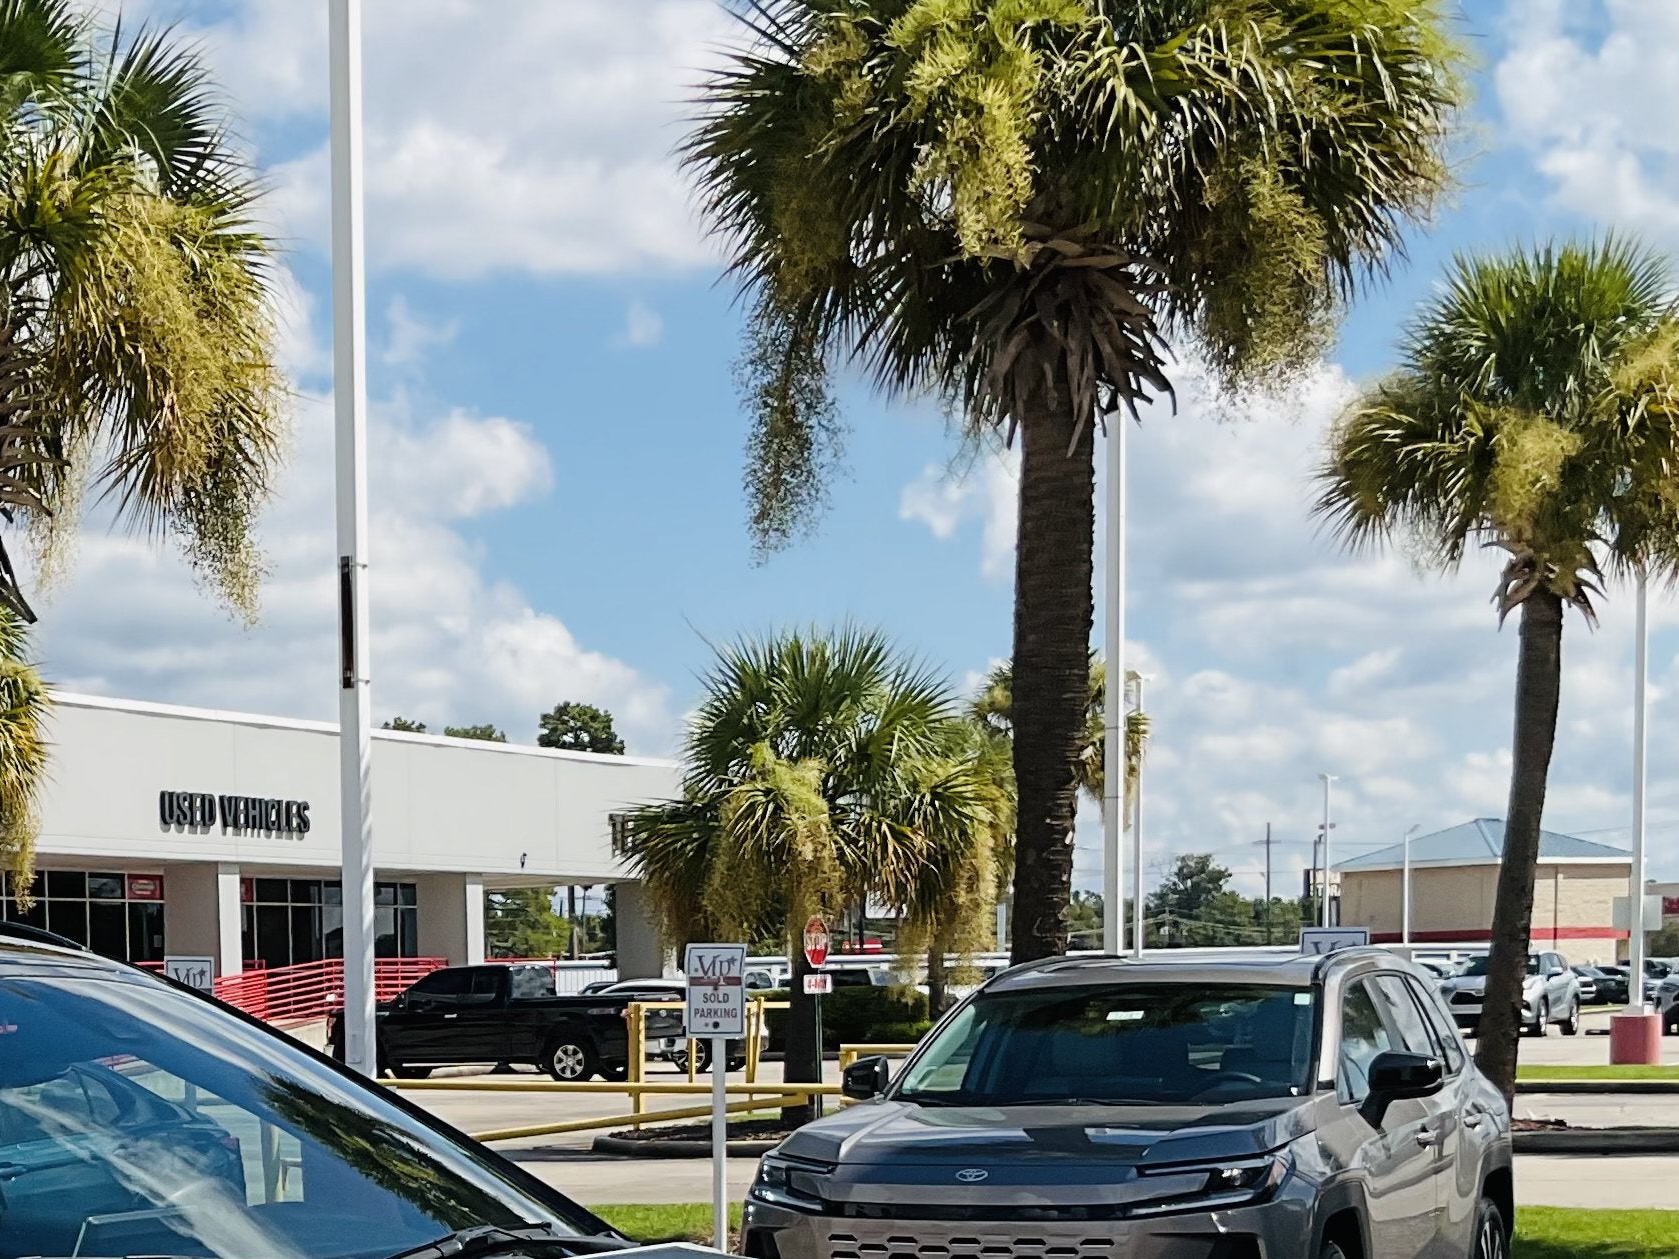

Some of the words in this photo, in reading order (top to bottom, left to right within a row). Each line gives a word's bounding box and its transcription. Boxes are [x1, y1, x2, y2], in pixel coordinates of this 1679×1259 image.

[160, 791, 216, 828] USED
[219, 795, 310, 834] VEHICLES
[703, 993, 730, 1004] SOLD
[694, 1007, 738, 1018] PARKING
